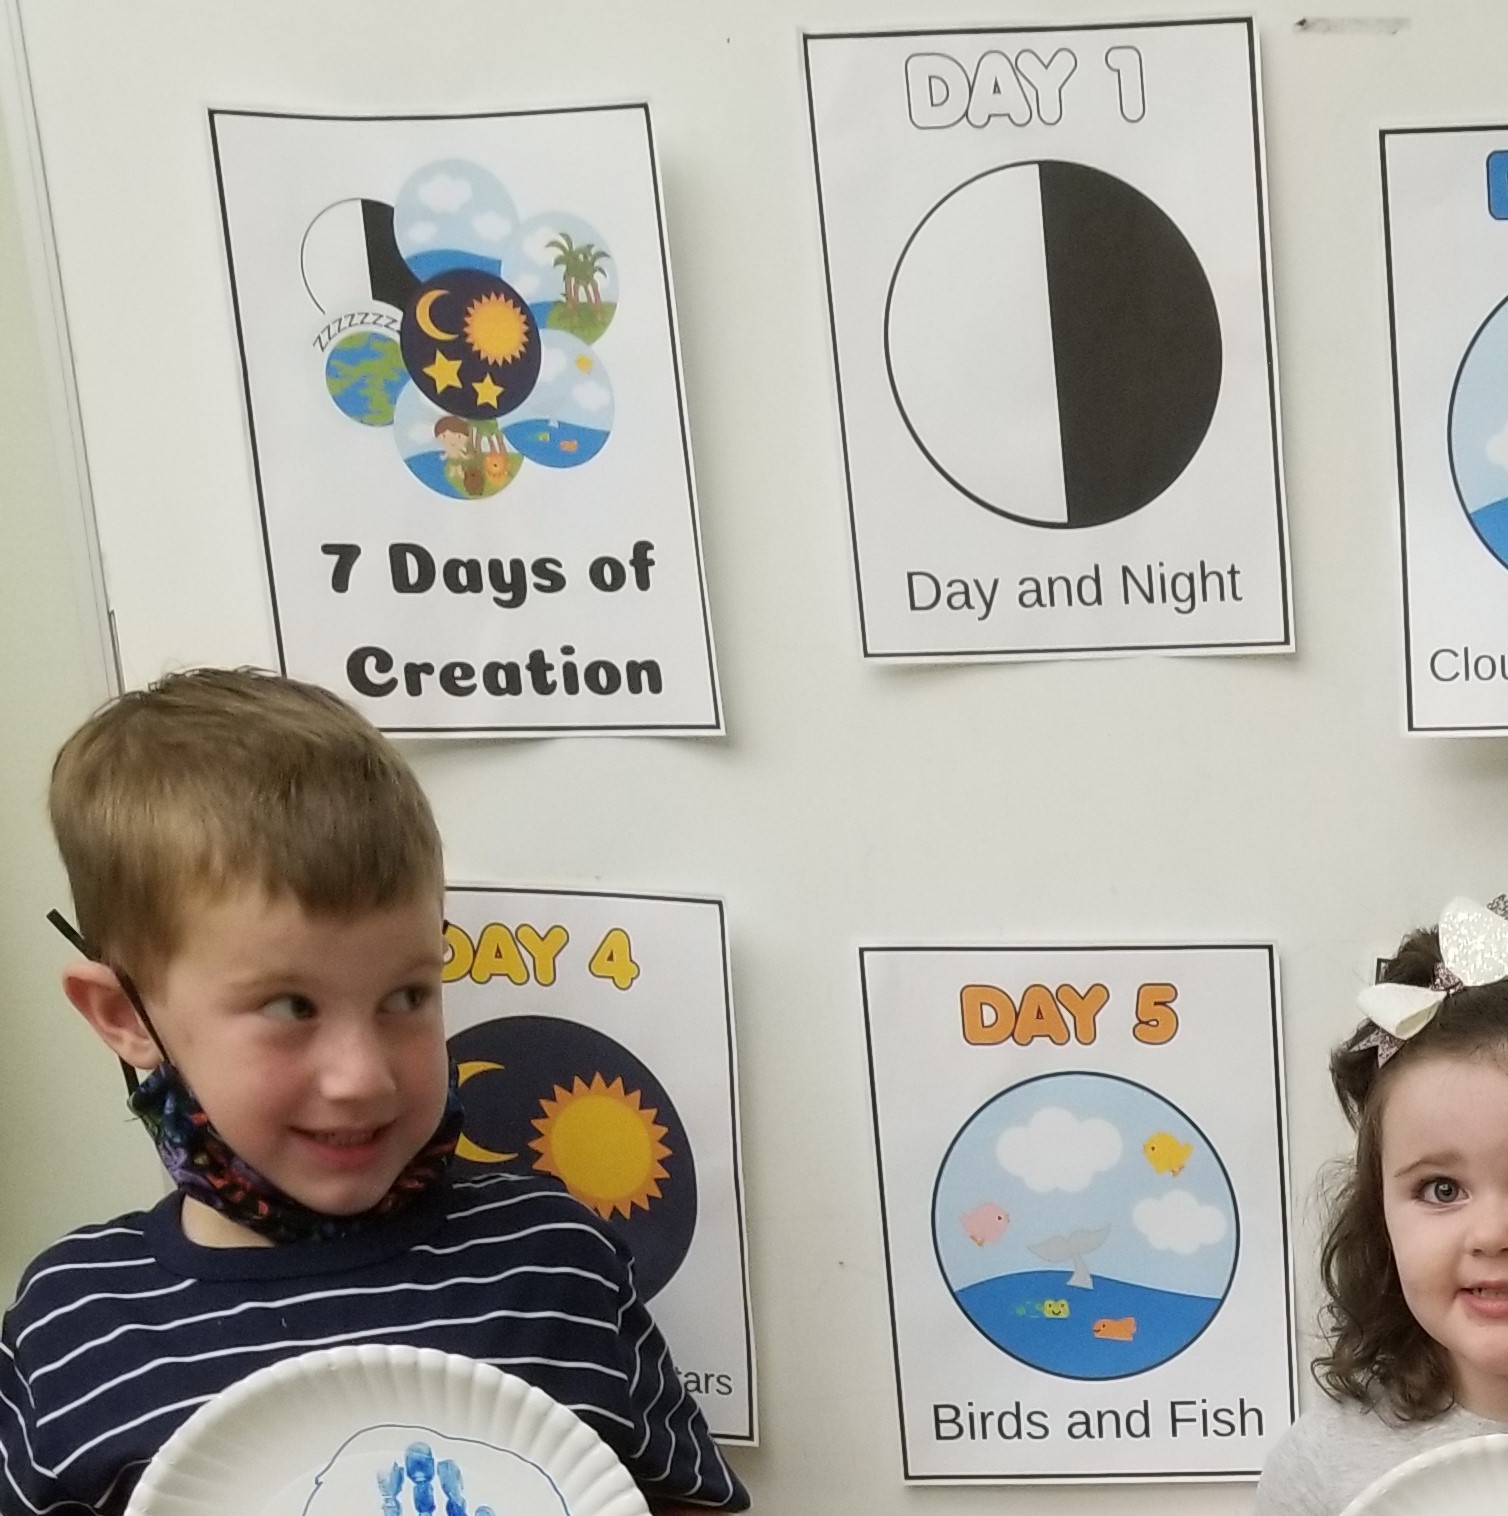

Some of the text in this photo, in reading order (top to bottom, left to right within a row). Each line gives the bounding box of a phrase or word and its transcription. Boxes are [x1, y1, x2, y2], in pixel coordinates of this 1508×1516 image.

[905, 46, 1145, 130] DAY 1
[321, 540, 655, 609] 7 Days of
[907, 560, 1243, 621] Day and Night
[346, 645, 663, 698] Creation
[588, 928, 640, 991] 4
[960, 983, 1179, 1046] DAY 5
[933, 1398, 1263, 1440] Birds and Fish
